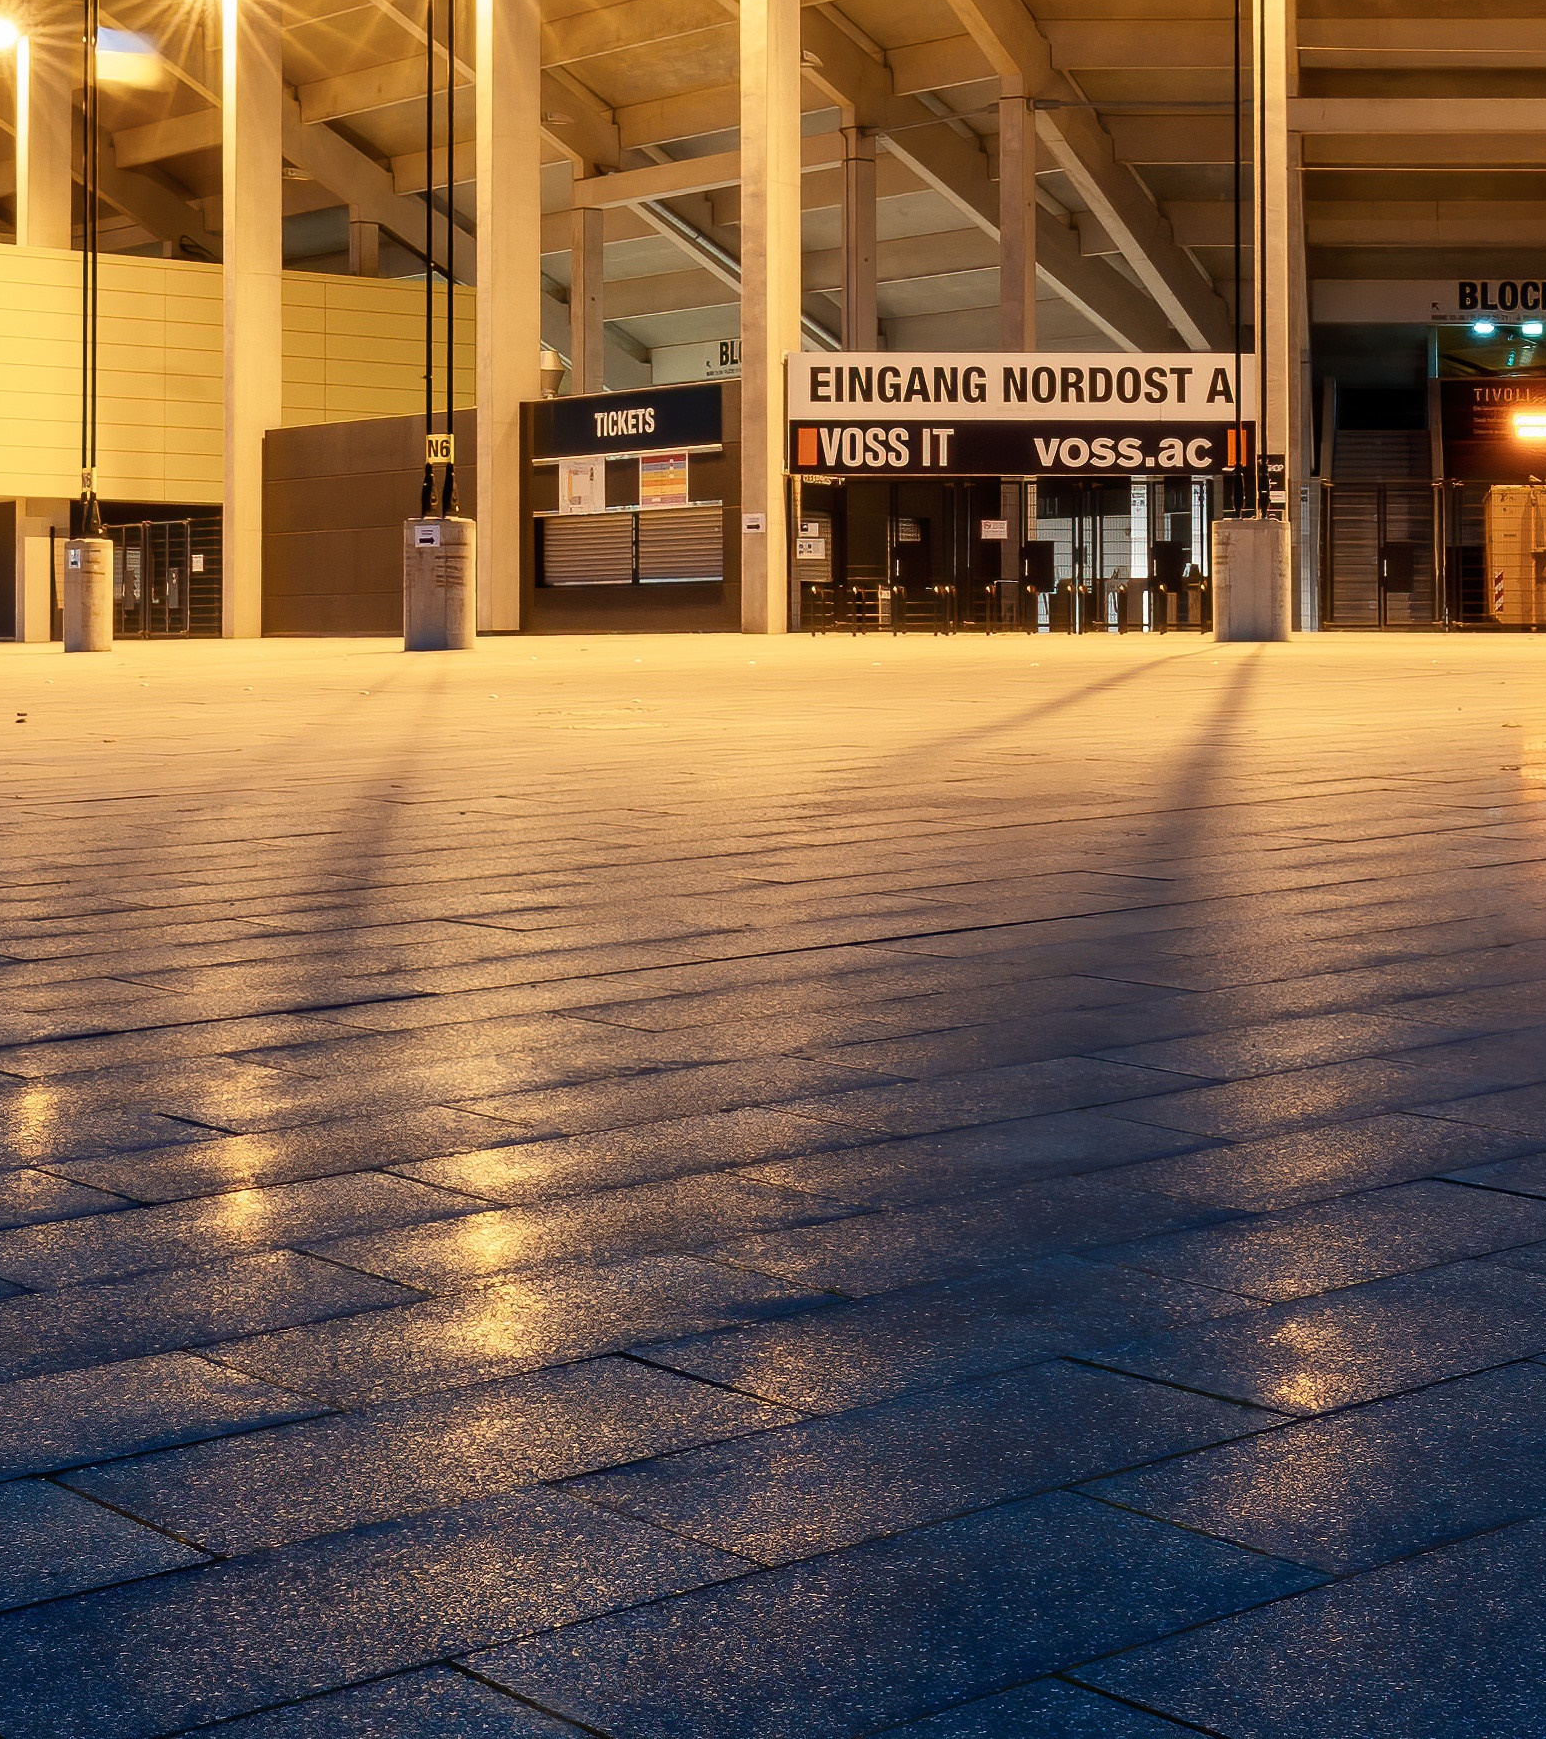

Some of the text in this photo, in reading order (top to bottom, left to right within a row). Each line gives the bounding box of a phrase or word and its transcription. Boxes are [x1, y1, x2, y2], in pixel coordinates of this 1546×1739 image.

[809, 366, 1235, 403] EINGANG NORDOST A
[1473, 388, 1532, 403] TIVOLI
[594, 407, 655, 437] TICKETS
[427, 440, 451, 457] N6
[819, 427, 955, 467] VOSS IT
[1034, 437, 1213, 468] voss.ac
